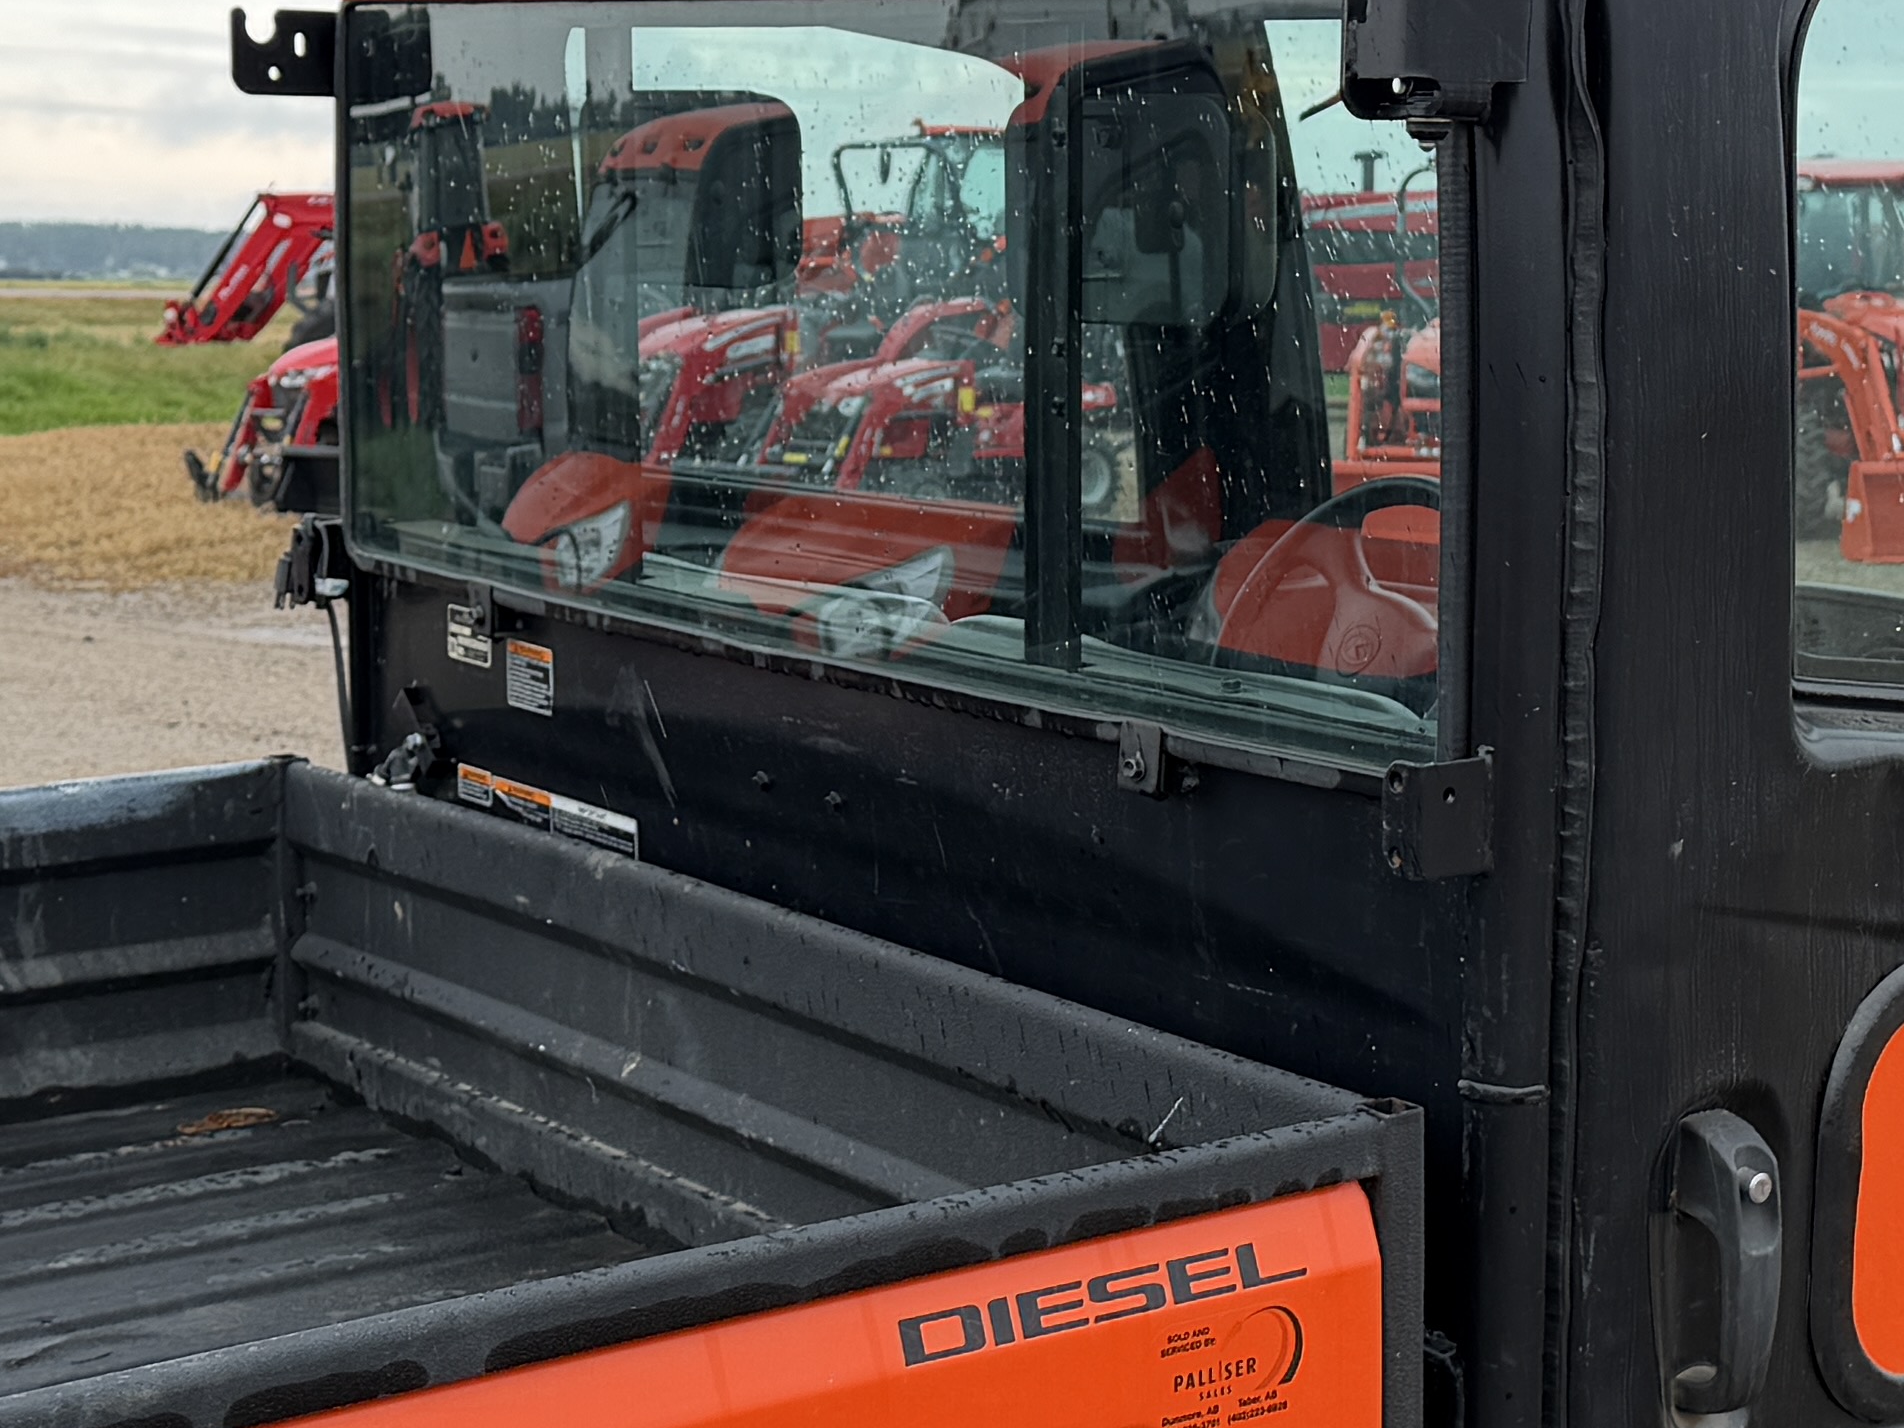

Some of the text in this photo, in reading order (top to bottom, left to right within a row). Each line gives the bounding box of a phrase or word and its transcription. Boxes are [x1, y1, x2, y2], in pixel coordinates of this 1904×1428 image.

[898, 1242, 1308, 1368] DIESEL
[1167, 1326, 1210, 1345] SOLD AND
[1173, 1357, 1257, 1393] PALLISER
[1199, 1385, 1233, 1401] SALES
